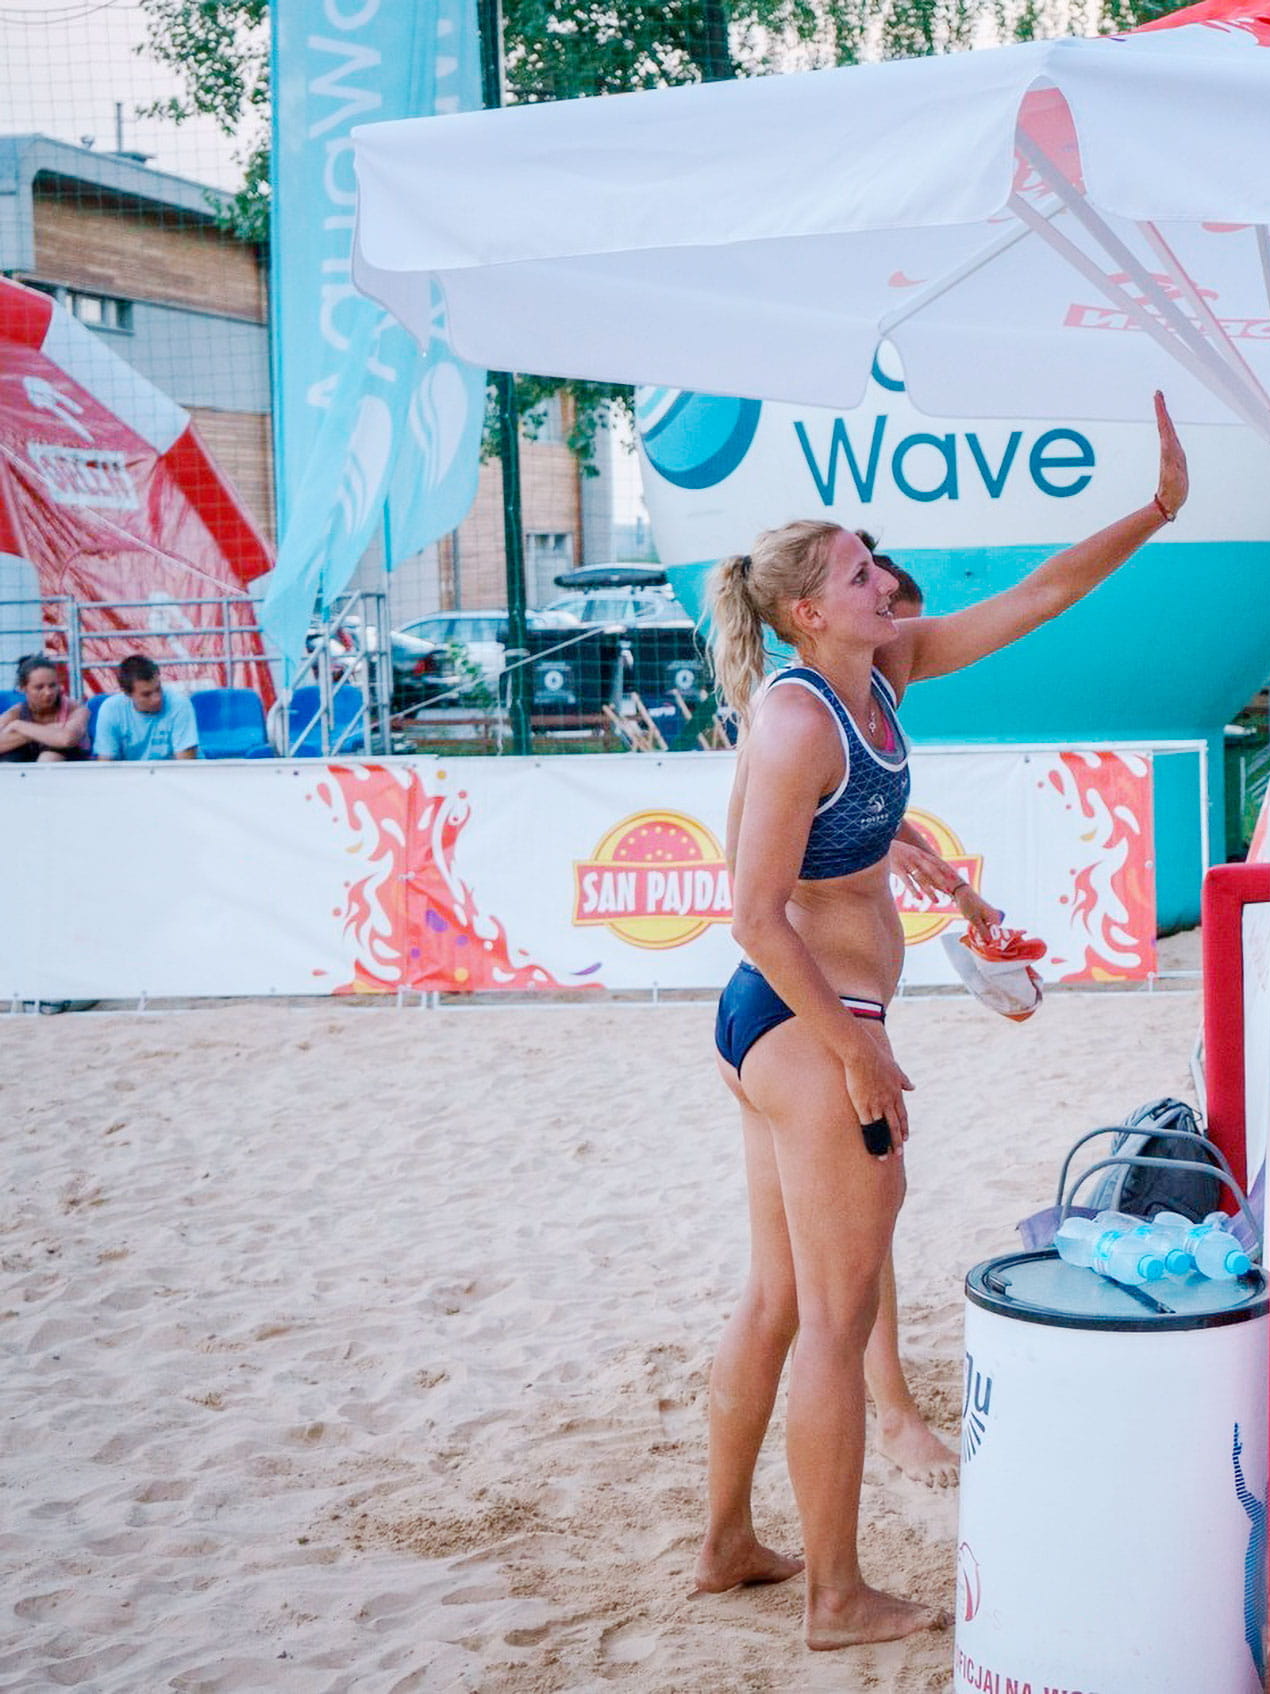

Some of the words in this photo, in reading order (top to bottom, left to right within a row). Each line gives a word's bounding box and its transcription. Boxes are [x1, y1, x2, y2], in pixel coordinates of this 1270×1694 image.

[793, 414, 1096, 507] Wave
[582, 871, 637, 913] SAN
[646, 869, 733, 915] PAJDA
